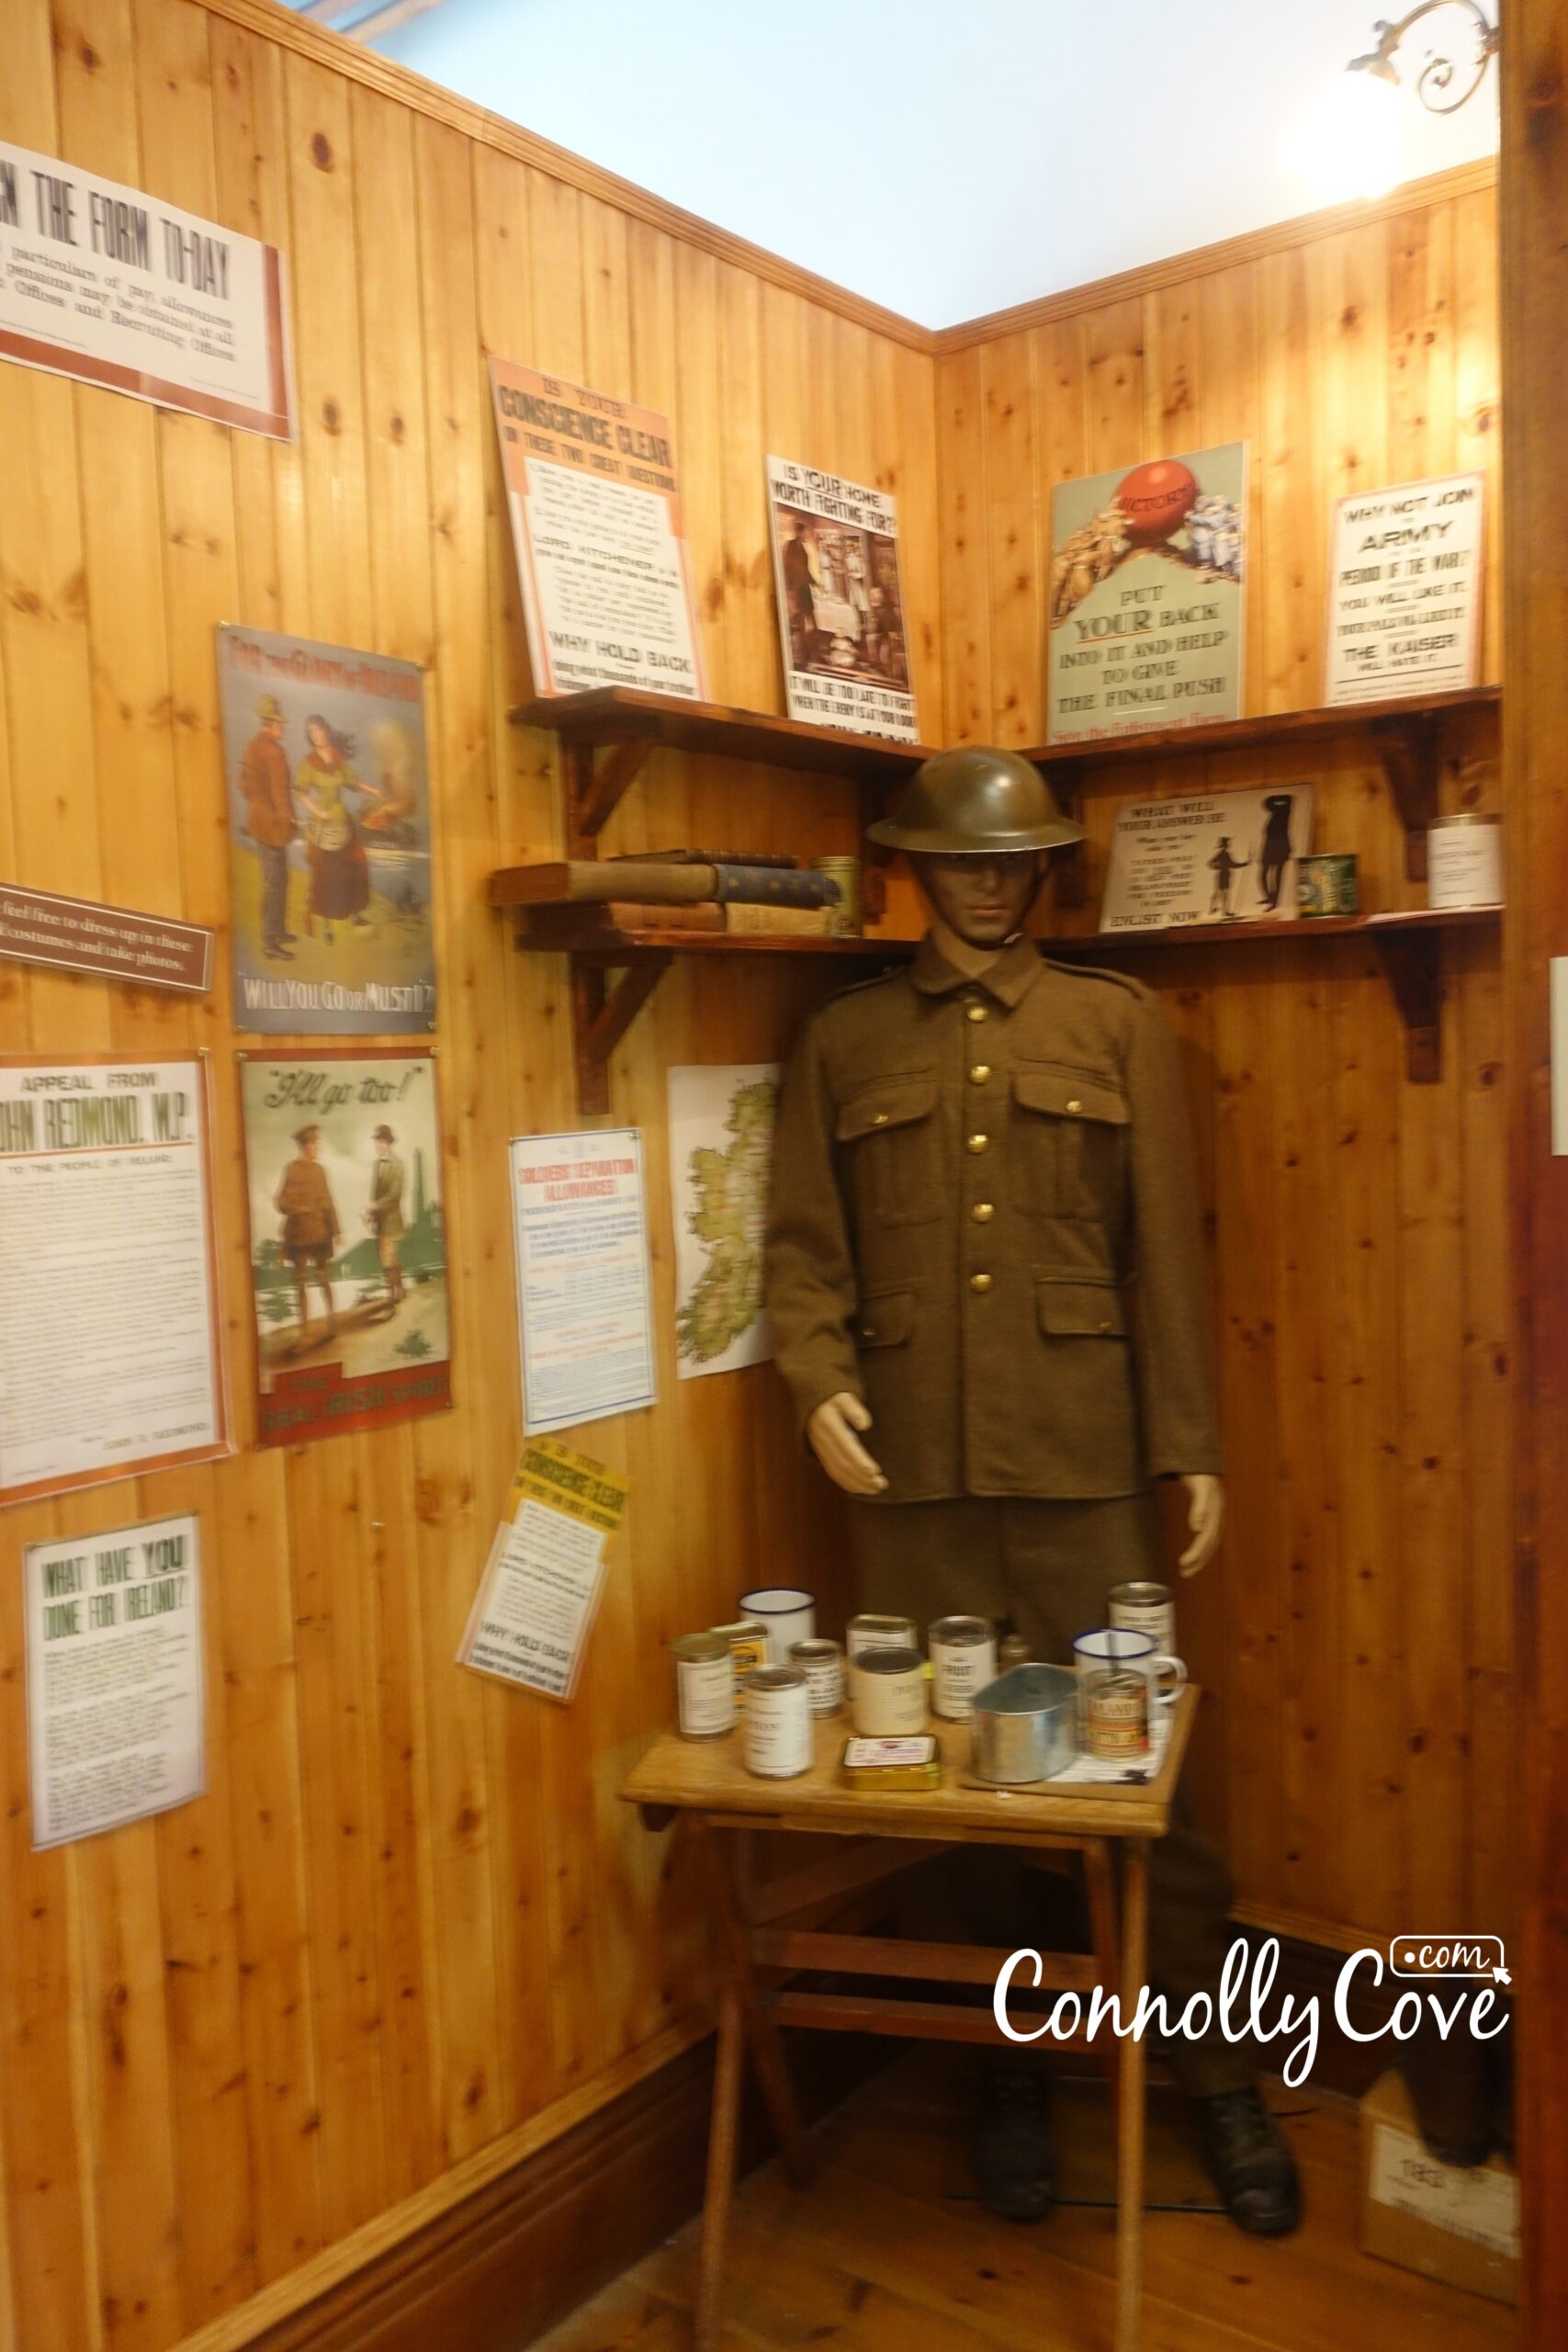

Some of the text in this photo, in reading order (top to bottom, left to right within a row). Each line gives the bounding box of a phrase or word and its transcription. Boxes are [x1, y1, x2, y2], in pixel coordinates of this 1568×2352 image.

[30, 169, 79, 247] THE
[88, 190, 152, 271] FORM
[5, 262, 235, 345] pensions may be obtained at all
[11, 245, 97, 283] particulars
[104, 276, 120, 290] of
[161, 295, 233, 329] allowances
[14, 280, 66, 308] Offices
[74, 301, 103, 320] and
[110, 310, 185, 348] Recruiting
[191, 338, 235, 362] Offices
[541, 376, 626, 420] IS YOUR
[498, 384, 673, 469] CONSCIENCE CLEAR
[524, 429, 557, 457] THESE
[771, 479, 810, 506] WORTH
[813, 492, 863, 526] FIGHTING
[784, 463, 882, 509] IS YOUR HOME
[1345, 488, 1475, 525] WHY NOT JOIN
[1359, 519, 1455, 553] ARMY
[1404, 557, 1426, 575] THE
[1119, 584, 1165, 607] PUT
[1338, 597, 1369, 612] YOU
[1374, 591, 1407, 606] WILL
[1073, 602, 1220, 640] YOUR BACK
[548, 630, 692, 673] WHY HOLD BACK
[1058, 629, 1230, 671] INTO IT AND HELP
[1342, 632, 1459, 662] THE KAISER
[1100, 659, 1179, 686] TO GIVE
[1358, 662, 1382, 672] WILL
[1057, 675, 1227, 715] THE FINAL PUSH
[1117, 820, 1150, 832] YOUR
[1151, 815, 1202, 829] ANSWER
[1130, 800, 1214, 820] WHAT WILL
[32, 906, 62, 925] free
[62, 916, 77, 929] to
[139, 930, 153, 944] in
[1110, 910, 1202, 927] ENLIST NOW
[8, 925, 74, 949] costumes
[76, 937, 104, 956] and
[106, 943, 135, 962] take
[243, 978, 287, 1010] WILL
[285, 978, 319, 1011] YOU
[321, 980, 346, 1011] GO
[346, 990, 362, 1011] OR
[365, 981, 413, 1012] MUST
[19, 1072, 159, 1093] APPEAL FROM
[319, 1082, 353, 1115] go
[8, 1166, 24, 1175] TO
[30, 1163, 55, 1173] THE
[59, 1159, 102, 1172] PEOPLE
[107, 1158, 121, 1168] OF
[40, 1534, 186, 1599] WHAT HAVE YOU
[480, 1620, 570, 1662] WHY HOLD BACK
[941, 1663, 976, 1677] FRUIT
